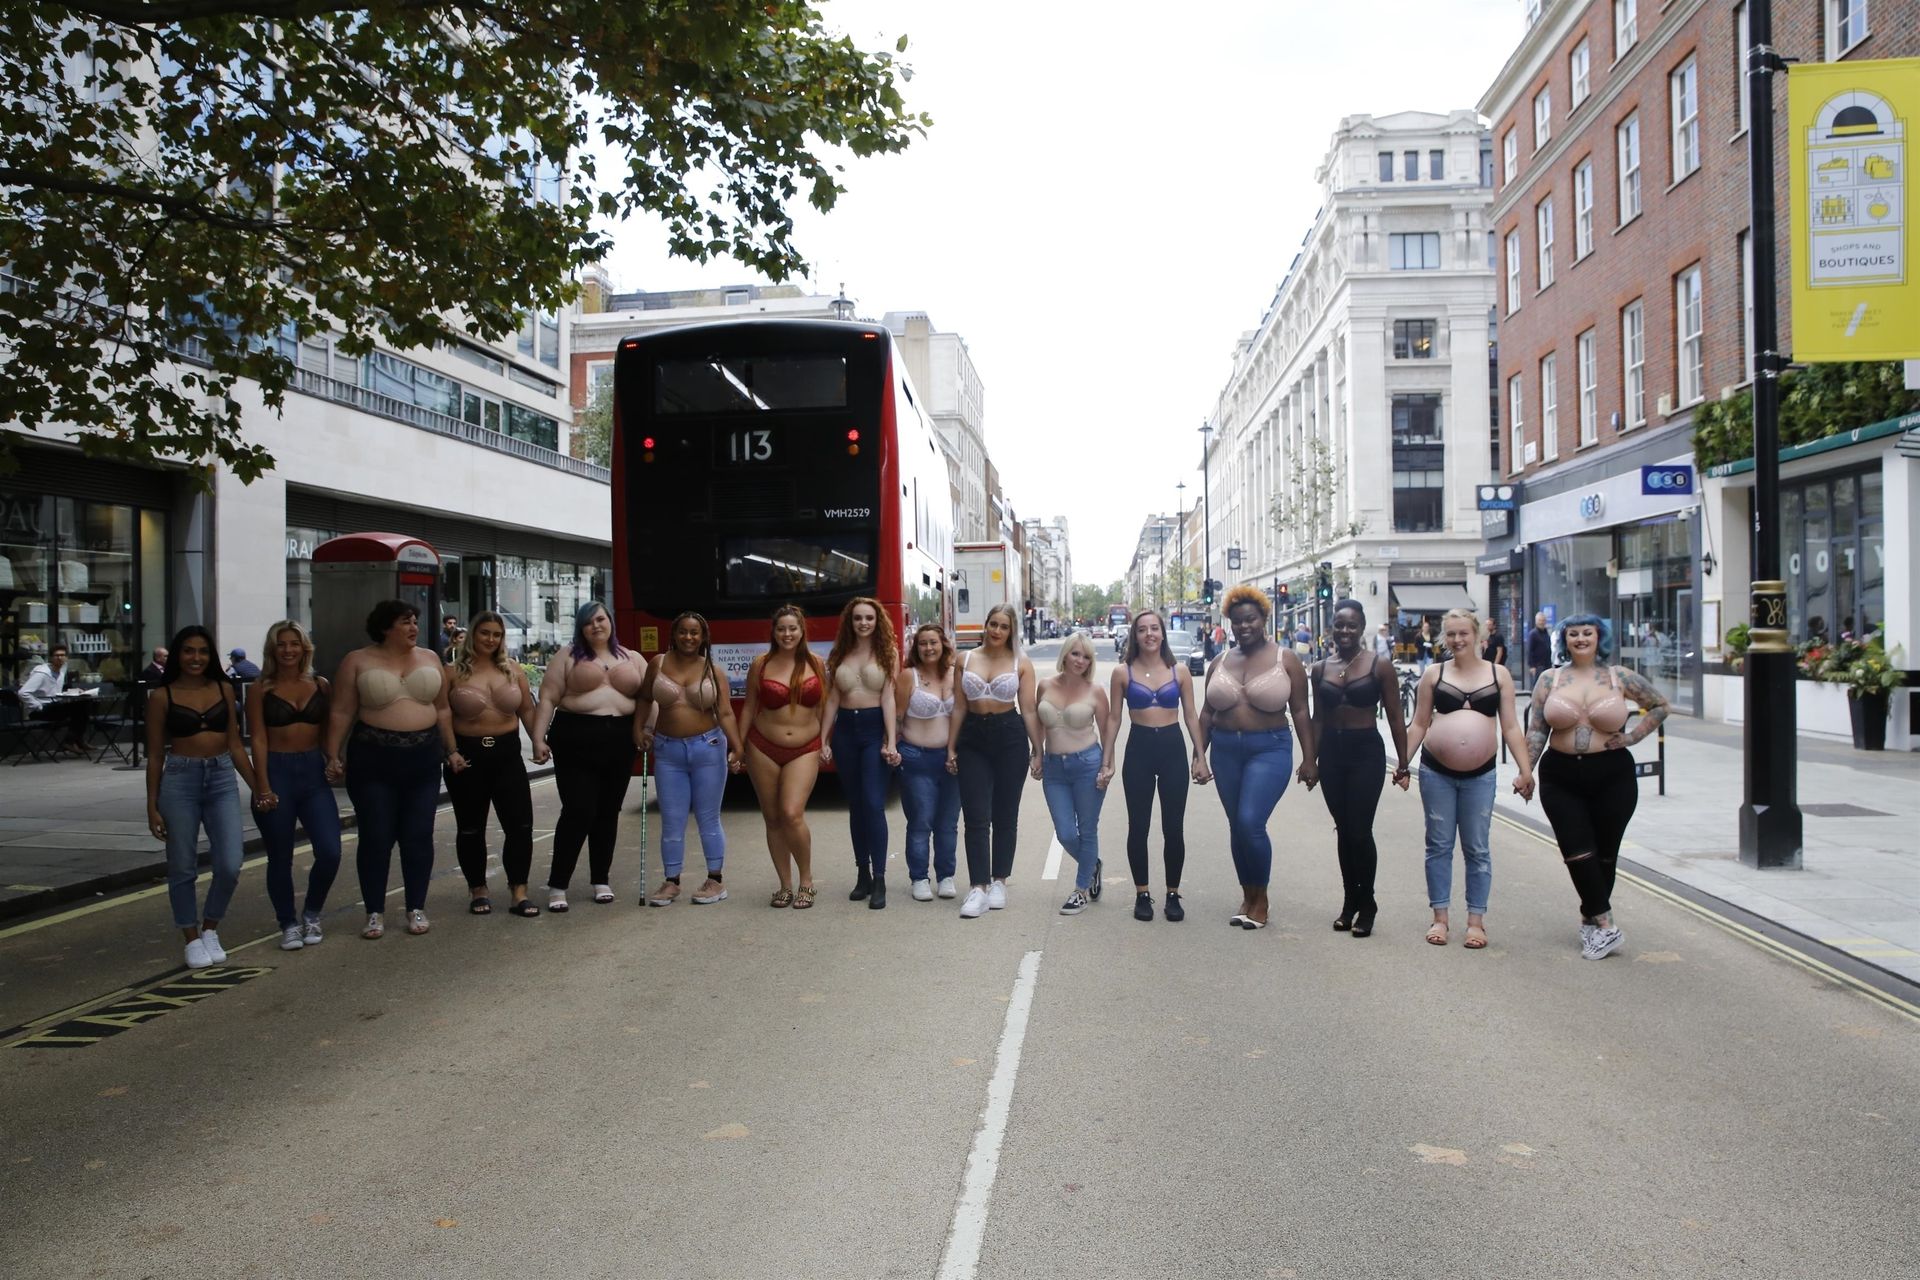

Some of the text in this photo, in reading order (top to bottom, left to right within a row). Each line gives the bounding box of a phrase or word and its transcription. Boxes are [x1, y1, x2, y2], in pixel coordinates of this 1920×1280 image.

[1830, 243, 1860, 254] SHOPS
[1819, 255, 1895, 268] BOUTIQUES
[731, 430, 772, 461] 113
[1712, 464, 1733, 476] OOTY
[1649, 473, 1686, 487] TSB
[1581, 495, 1600, 515] TSB
[824, 508, 870, 518] VMH2529
[0, 967, 273, 1048] TAXIS
